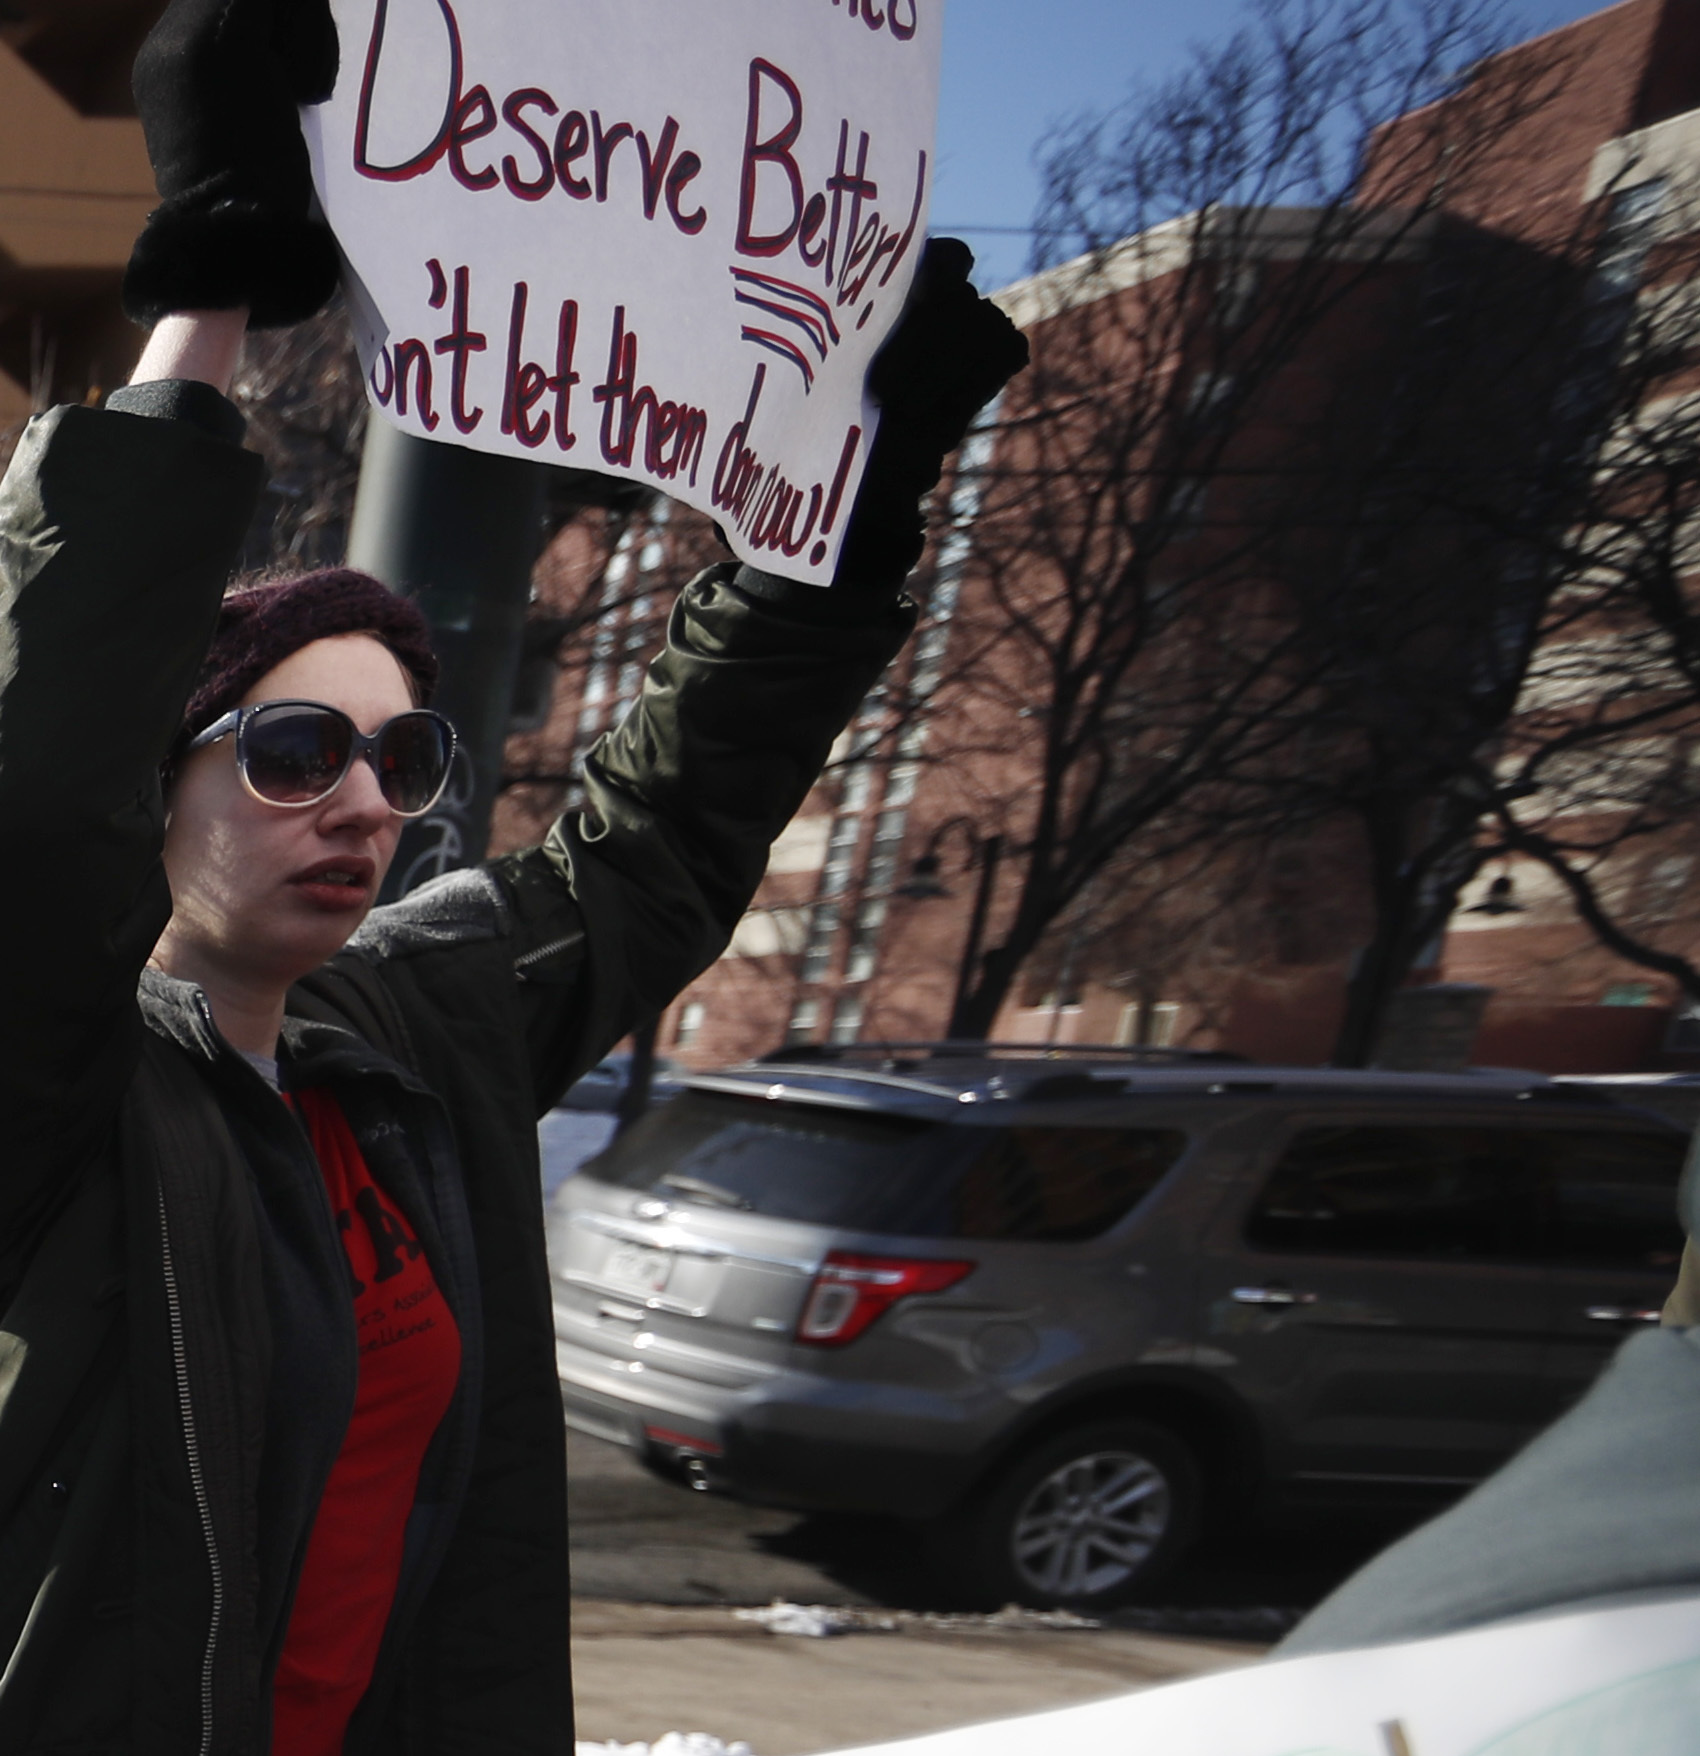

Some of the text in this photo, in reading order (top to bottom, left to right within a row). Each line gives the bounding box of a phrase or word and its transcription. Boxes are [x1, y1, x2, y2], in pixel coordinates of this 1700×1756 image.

[353, 0, 927, 331] Deserve Better!
[369, 257, 488, 435] on't
[500, 281, 579, 452] let
[592, 305, 709, 488] them
